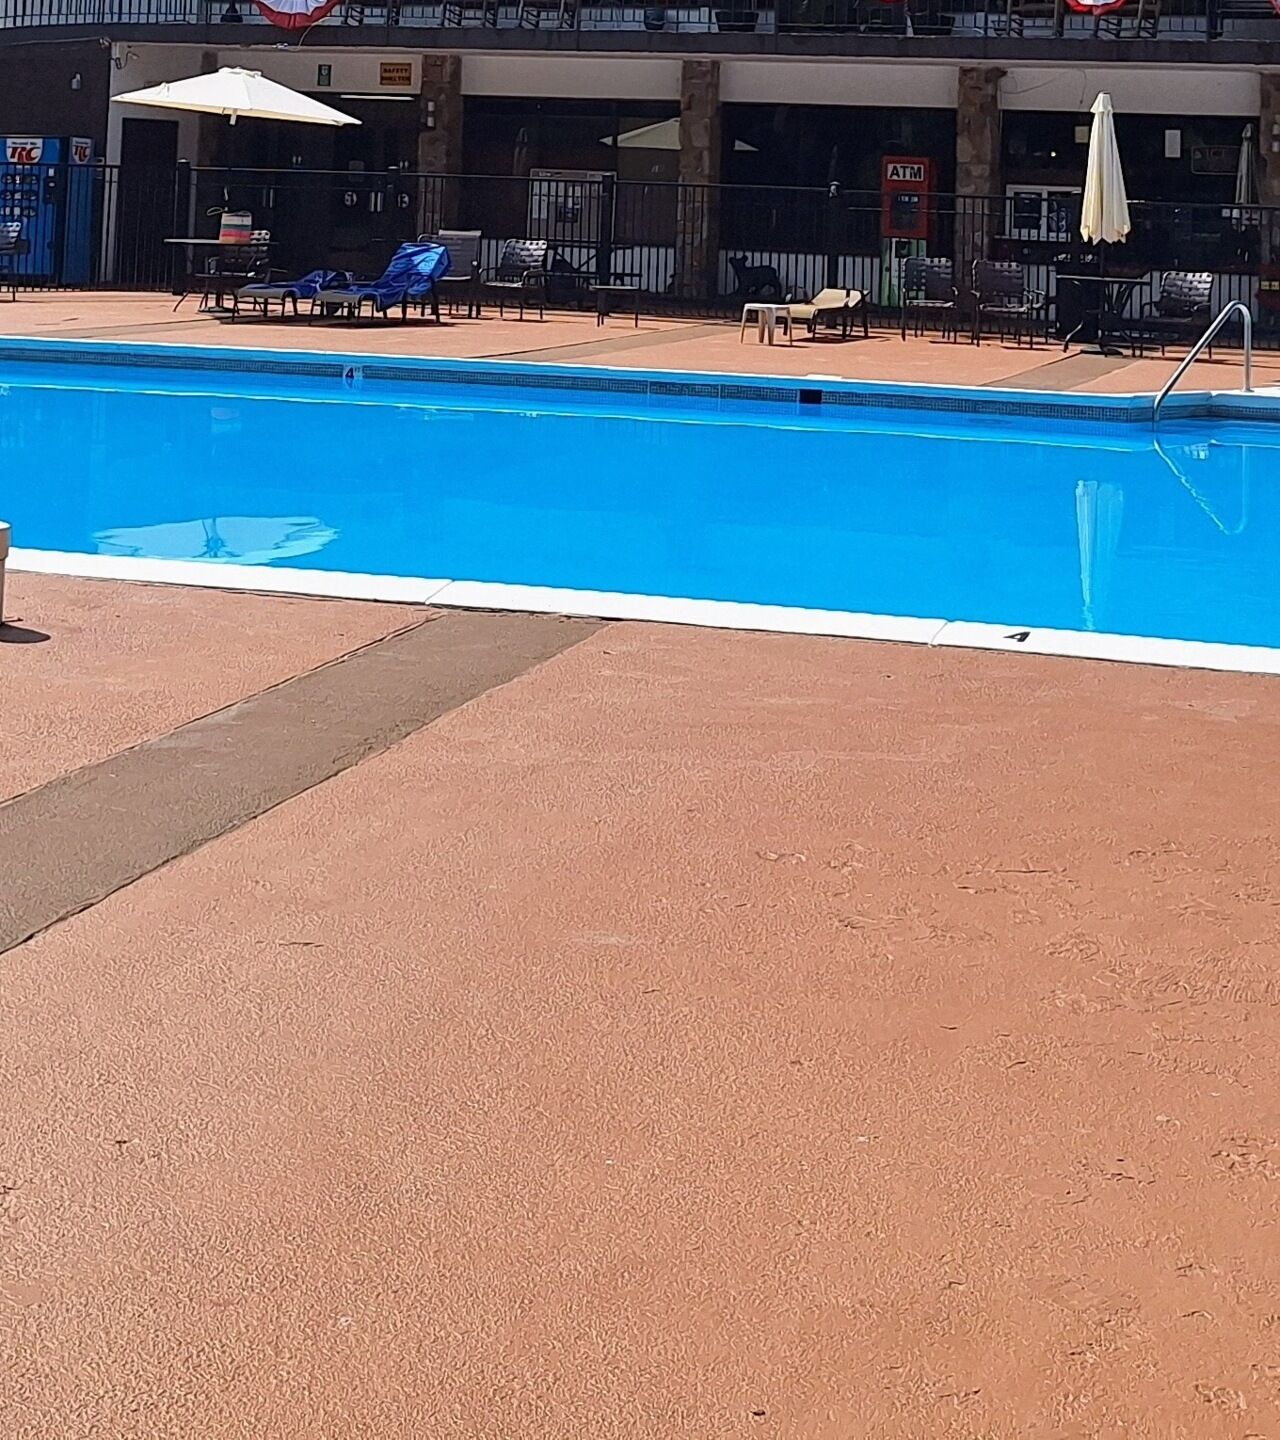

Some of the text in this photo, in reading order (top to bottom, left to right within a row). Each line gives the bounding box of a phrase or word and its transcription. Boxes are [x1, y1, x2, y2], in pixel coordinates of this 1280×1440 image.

[10, 147, 40, 163] RC
[75, 146, 89, 162] RC
[890, 165, 922, 179] ATM
[345, 366, 354, 378] 4
